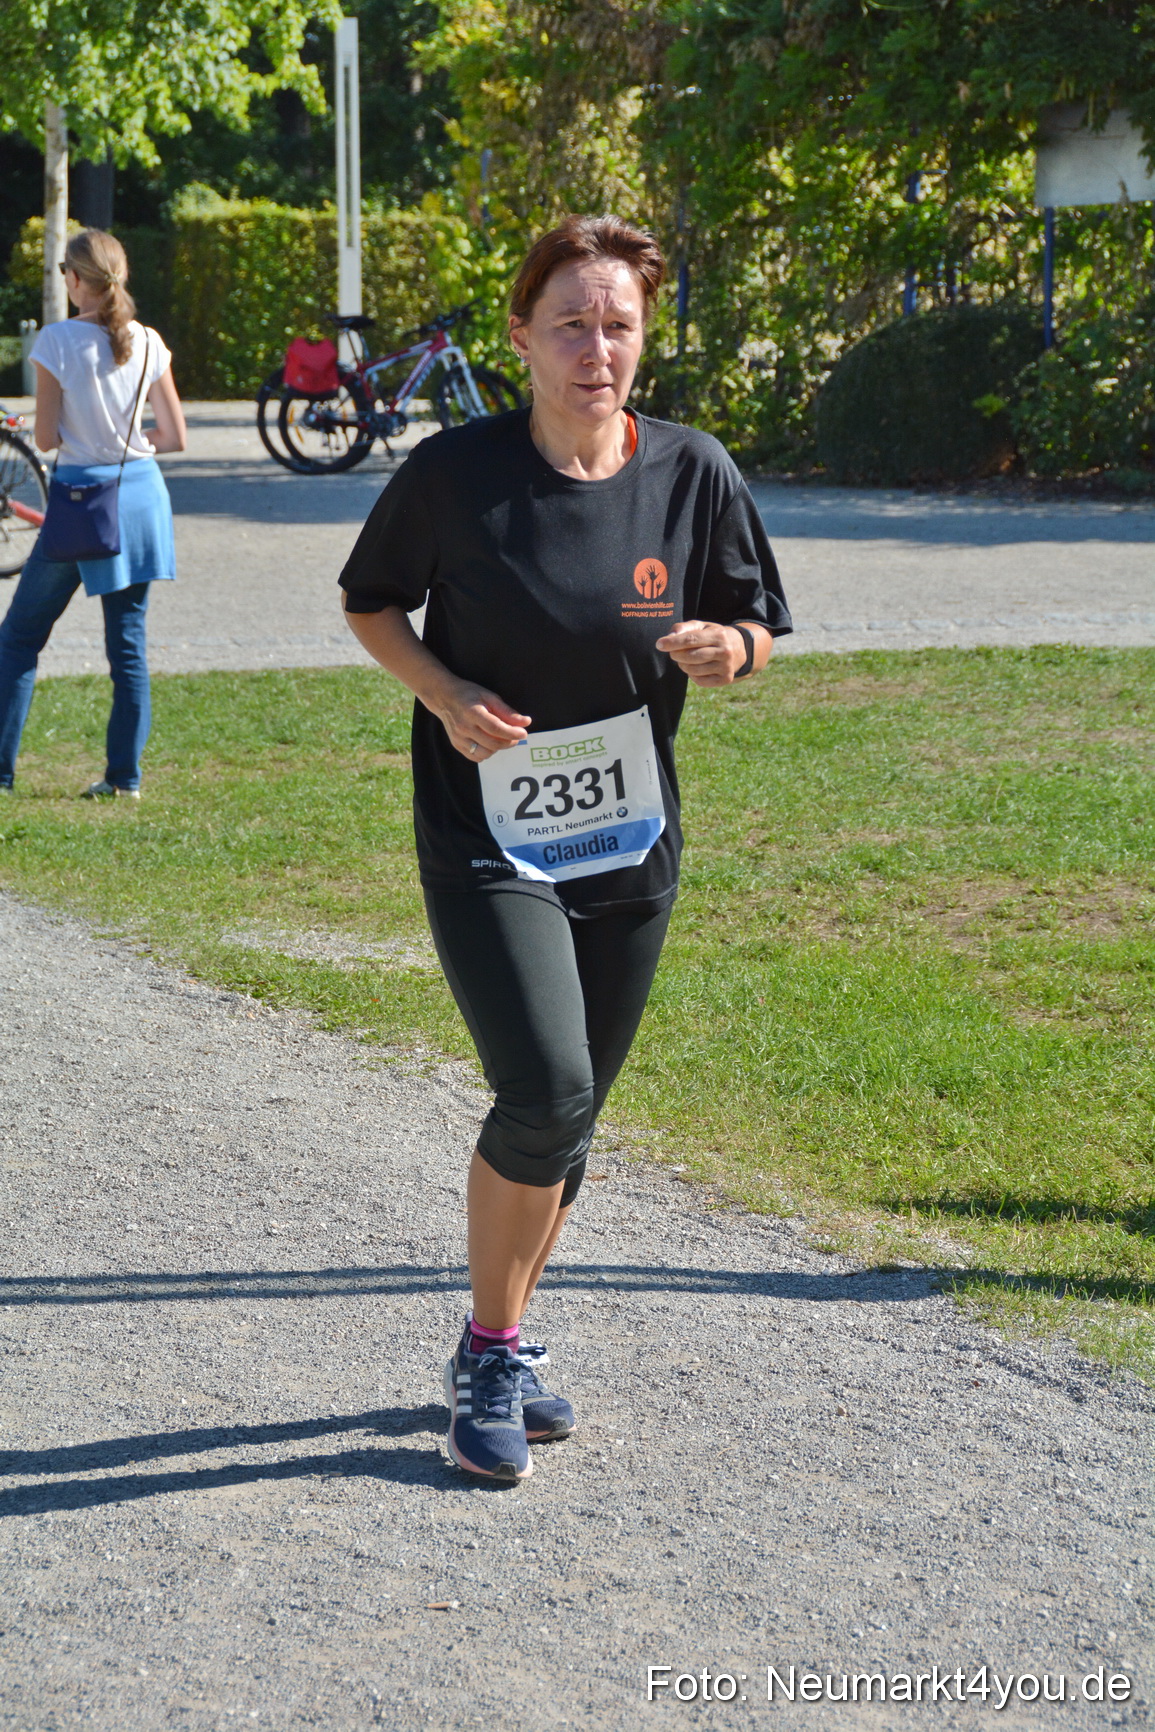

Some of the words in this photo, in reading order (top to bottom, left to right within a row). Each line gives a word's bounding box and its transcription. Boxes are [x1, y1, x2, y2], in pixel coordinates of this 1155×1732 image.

[531, 736, 606, 762] BOCK
[510, 758, 626, 821] 2331
[497, 814, 504, 824] D
[527, 824, 563, 837] PARTL
[565, 811, 613, 830] Neumarkt
[543, 833, 619, 865] Claudia
